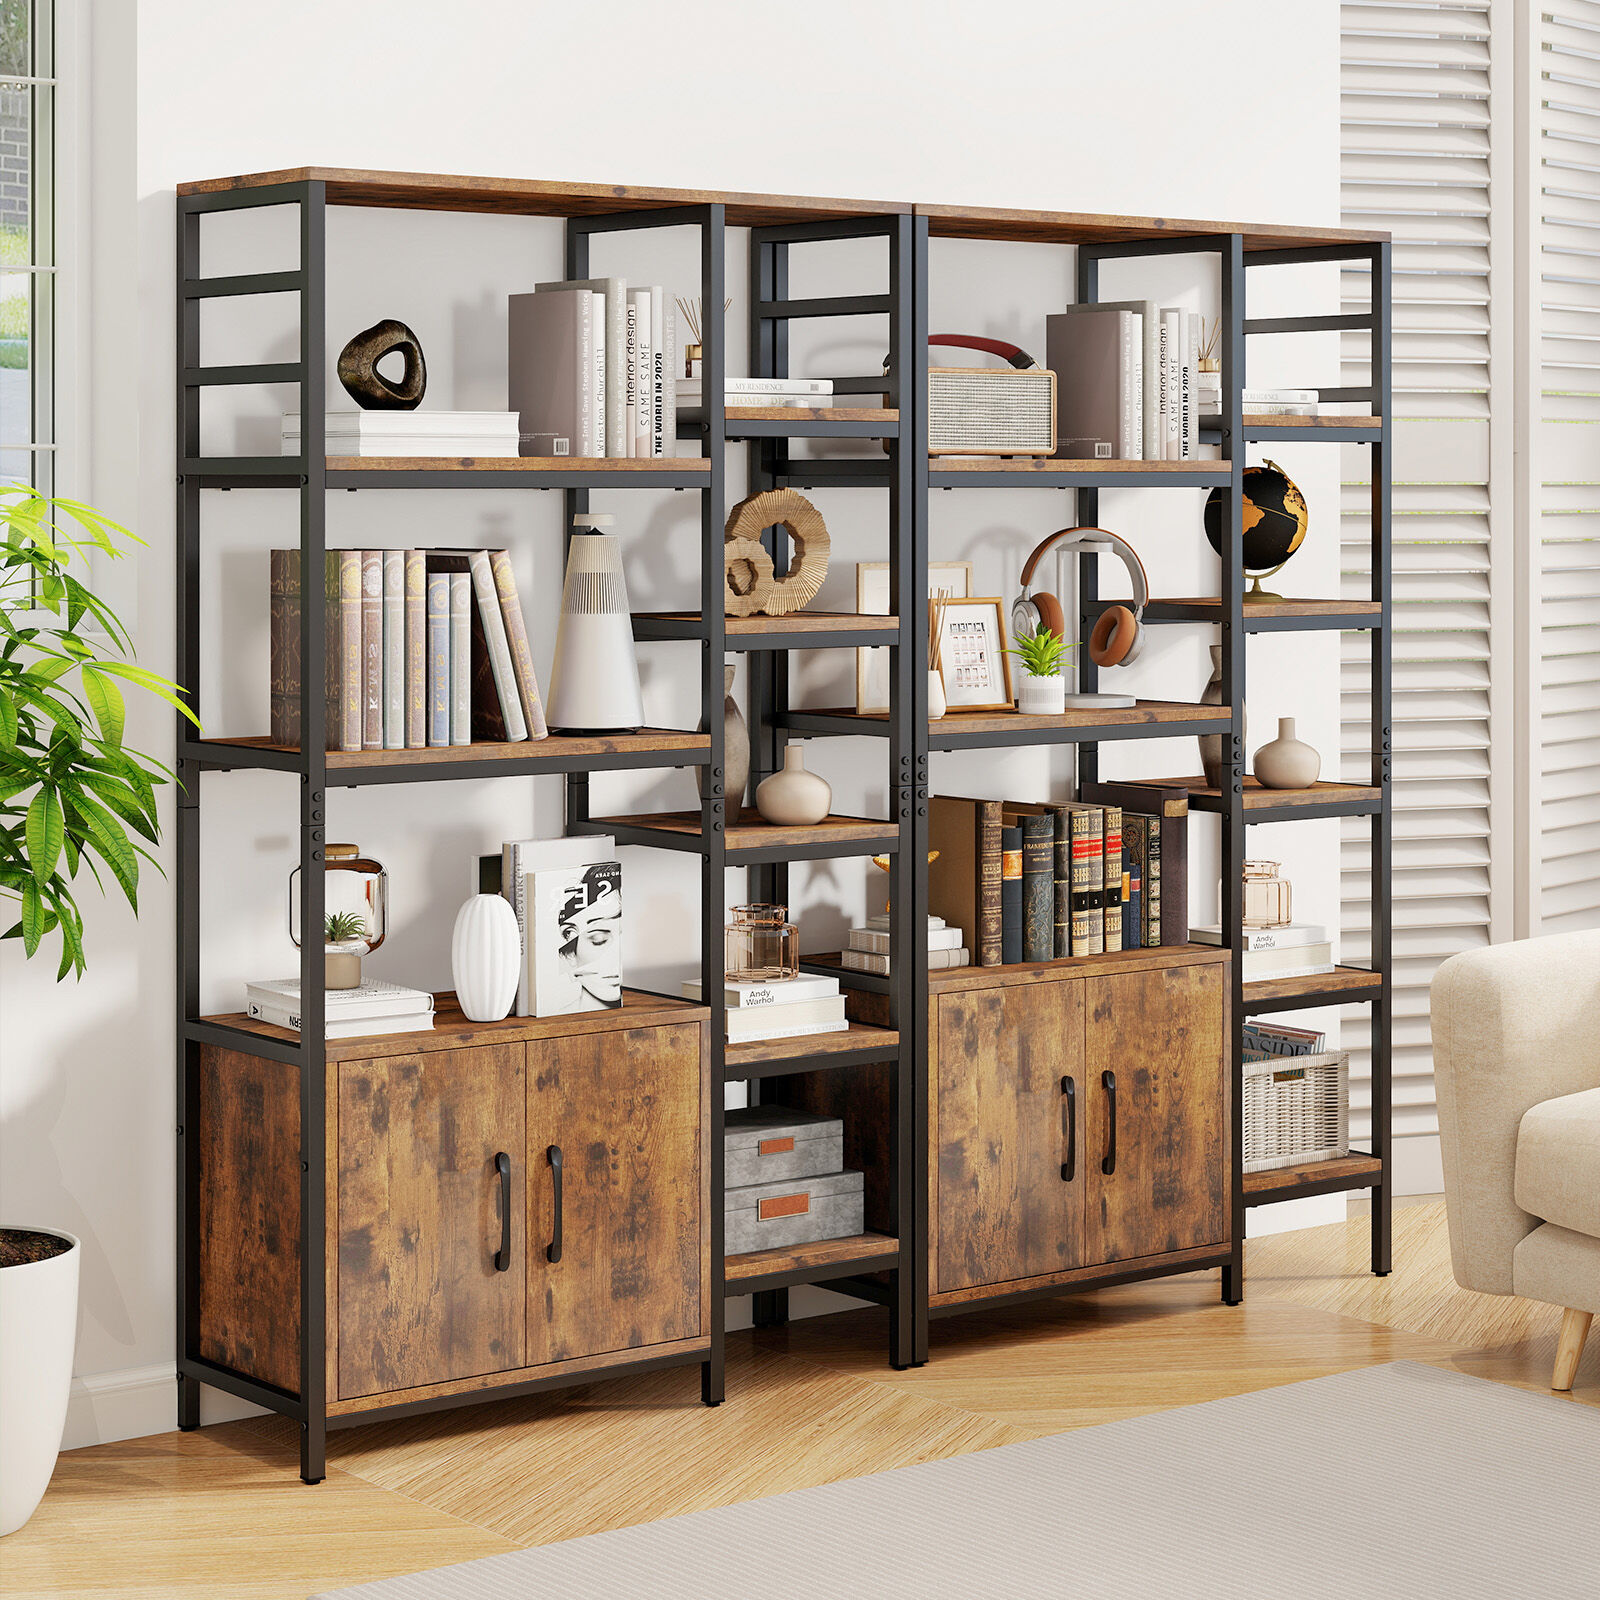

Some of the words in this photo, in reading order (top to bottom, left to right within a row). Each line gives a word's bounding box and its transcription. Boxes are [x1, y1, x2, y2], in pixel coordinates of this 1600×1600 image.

[626, 309, 636, 355] design
[596, 348, 604, 402] Churchill
[640, 343, 650, 380] SAME
[654, 352, 662, 380] 2020
[626, 358, 636, 406] Interior
[654, 382, 662, 394] IN
[1183, 393, 1189, 402] IN
[640, 389, 650, 426] SAME
[654, 395, 662, 433] WORLD
[596, 408, 604, 452] Winston
[654, 435, 662, 455] THE
[1253, 941, 1275, 949] Warhol
[746, 996, 774, 1006] Warhol
[749, 989, 771, 999] Andy
